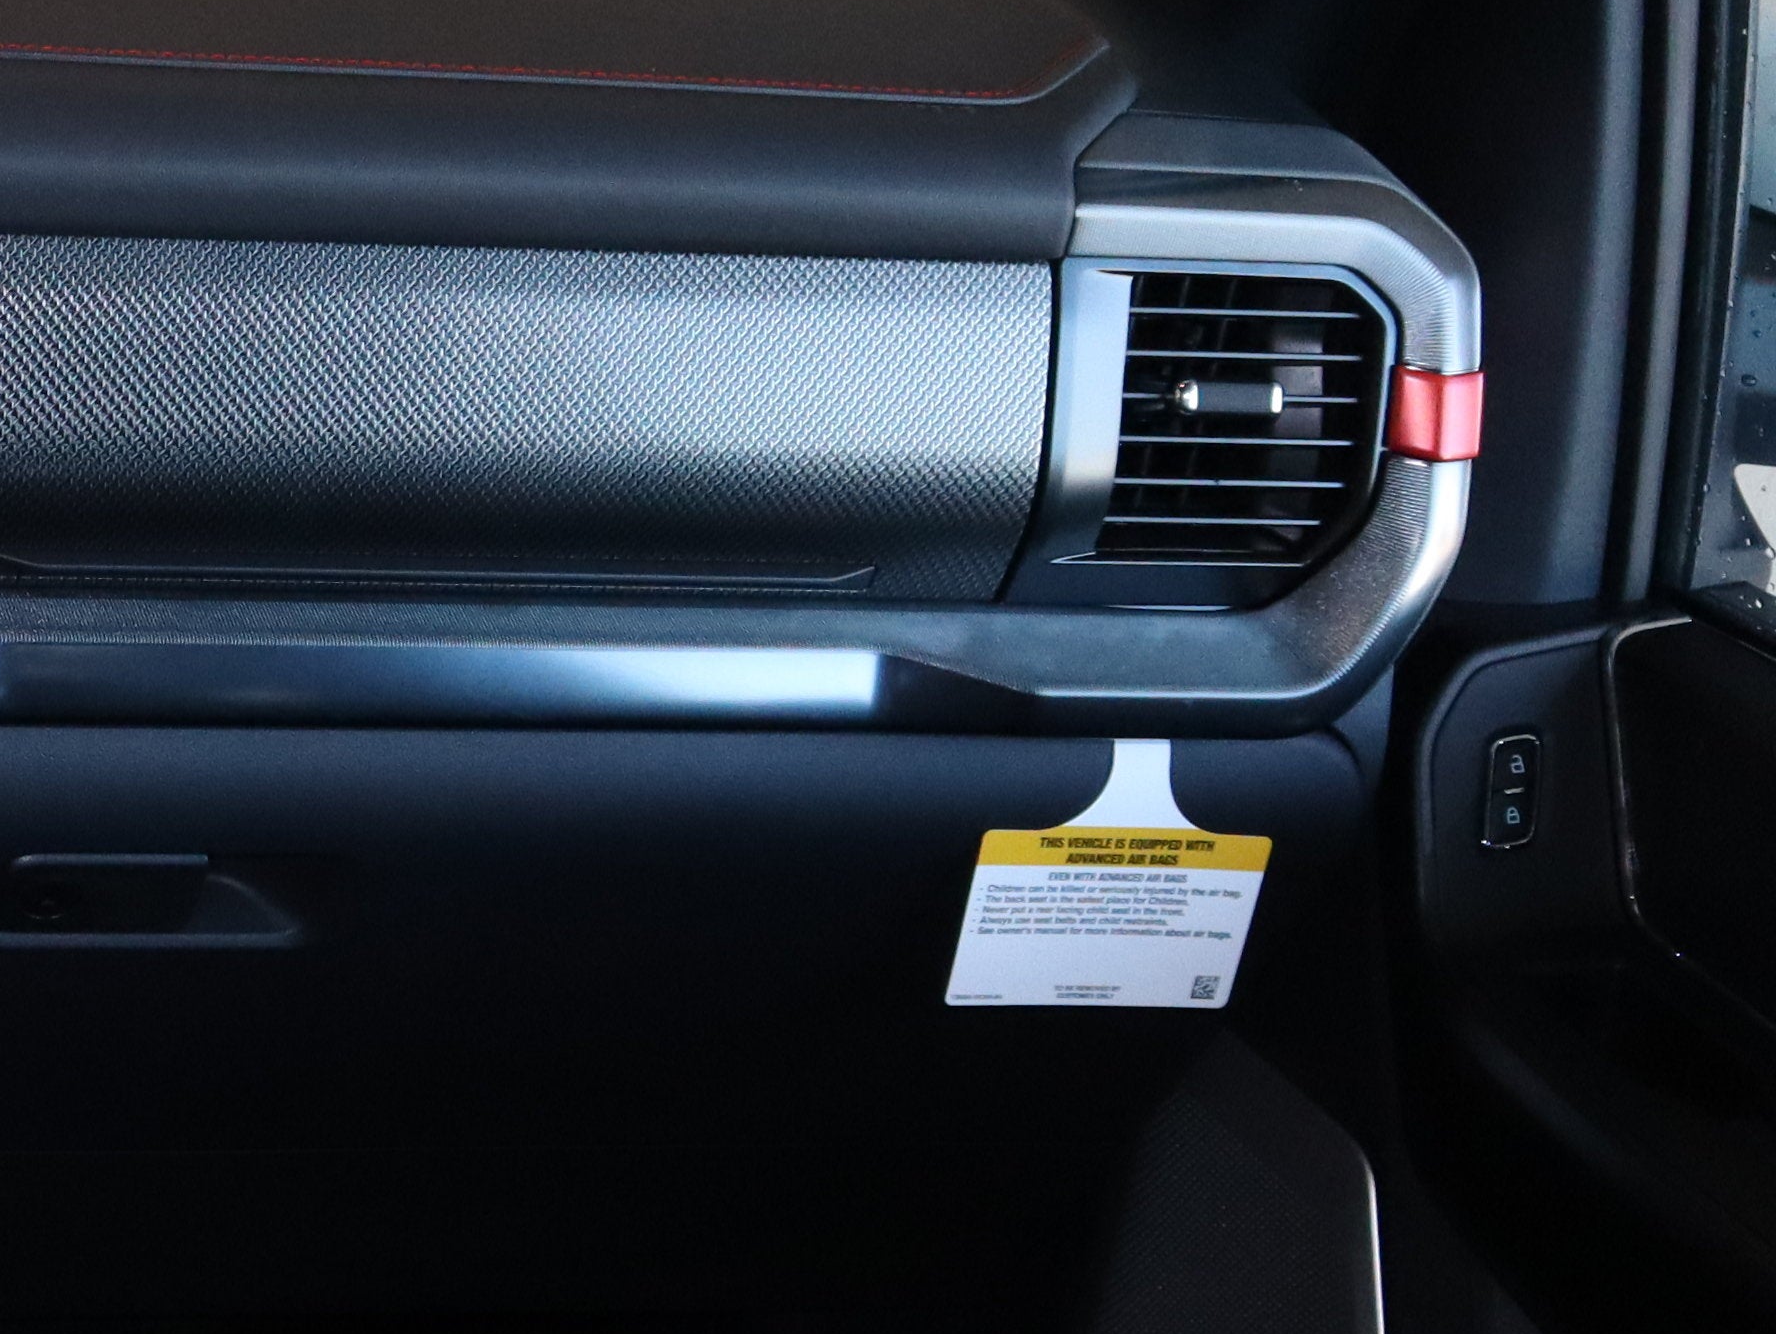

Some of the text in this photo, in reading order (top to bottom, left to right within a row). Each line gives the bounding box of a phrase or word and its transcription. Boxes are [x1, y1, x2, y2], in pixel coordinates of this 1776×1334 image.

[1039, 837, 1216, 852] THIS VEHICLE IS EQUIPPED WITH
[1065, 853, 1126, 865] ADVANCED
[1149, 854, 1179, 866] BAGS
